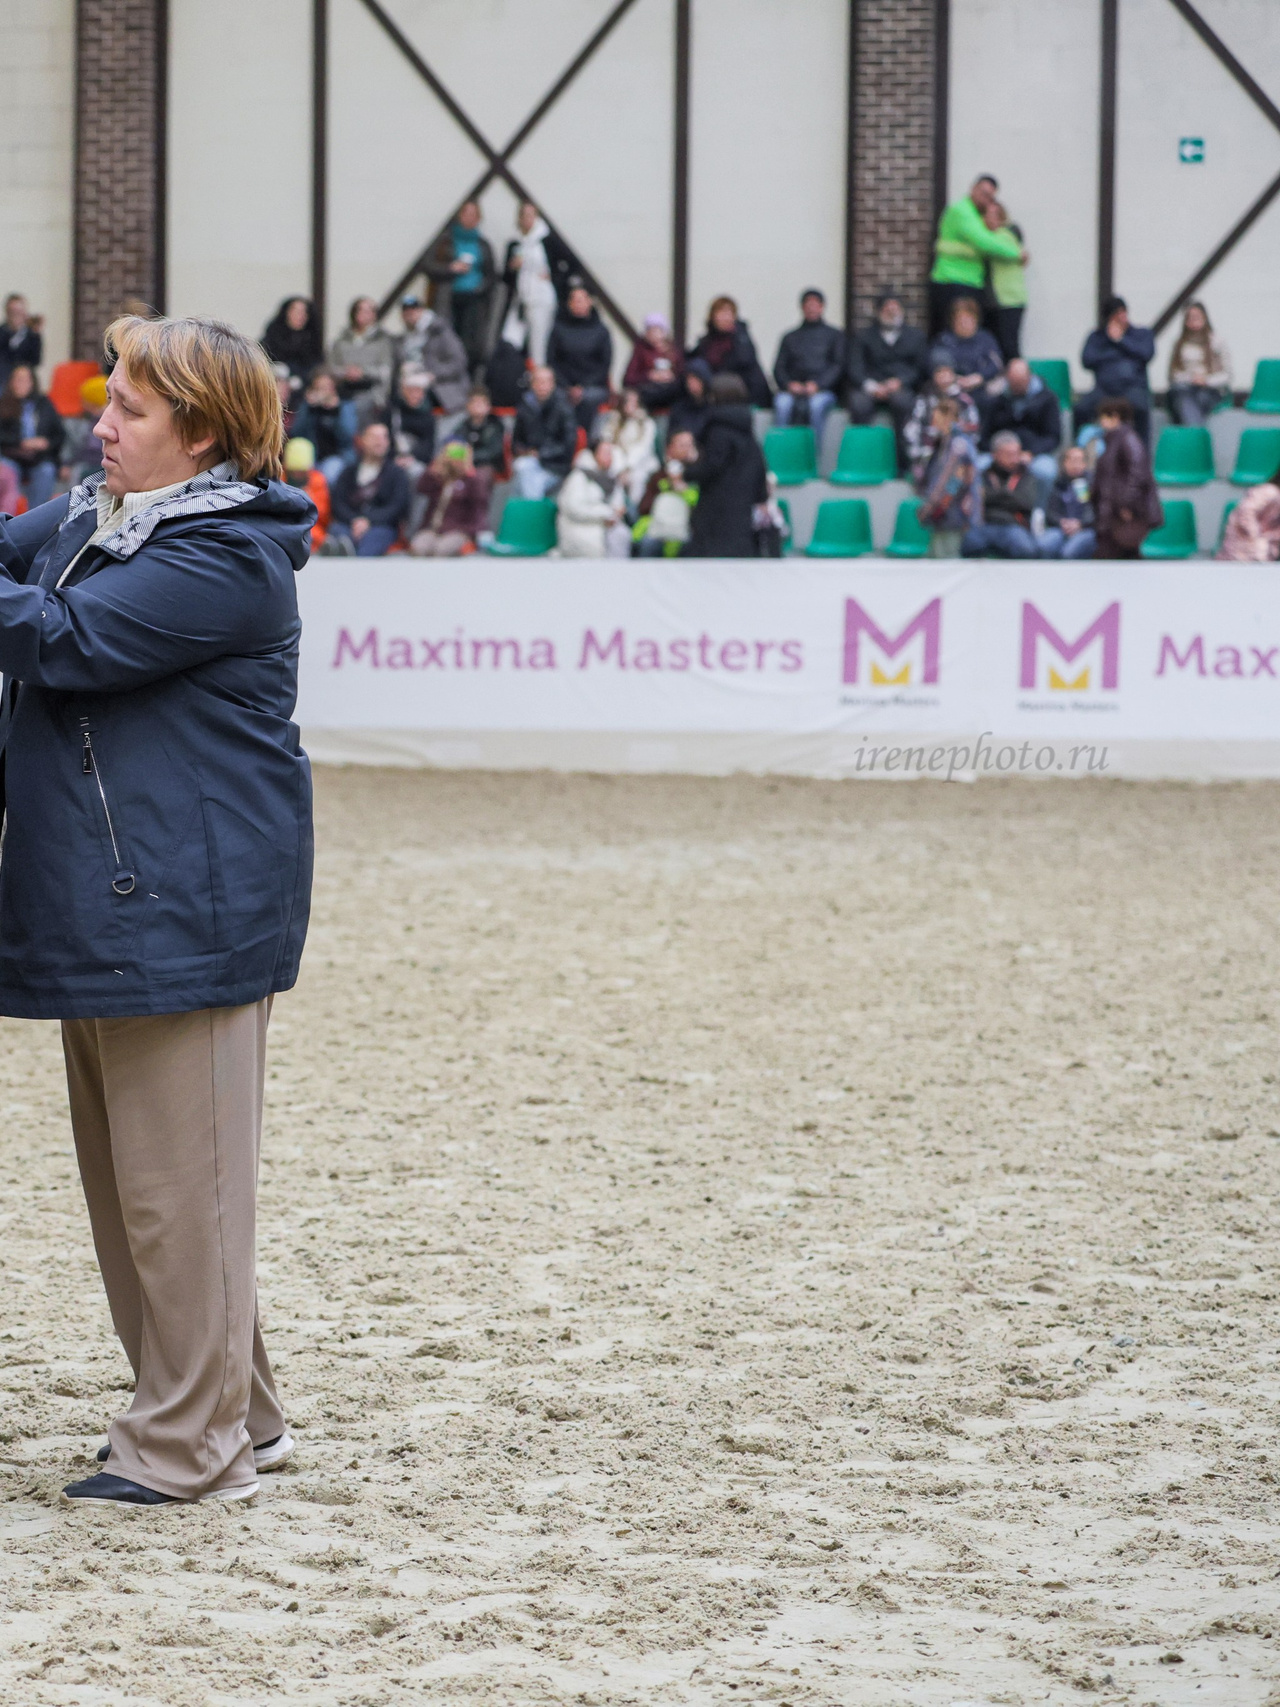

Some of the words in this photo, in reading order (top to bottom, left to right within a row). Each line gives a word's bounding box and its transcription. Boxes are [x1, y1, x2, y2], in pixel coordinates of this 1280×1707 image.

[330, 627, 557, 670] Maxima
[577, 628, 803, 672] Masters
[1156, 634, 1279, 677] Max
